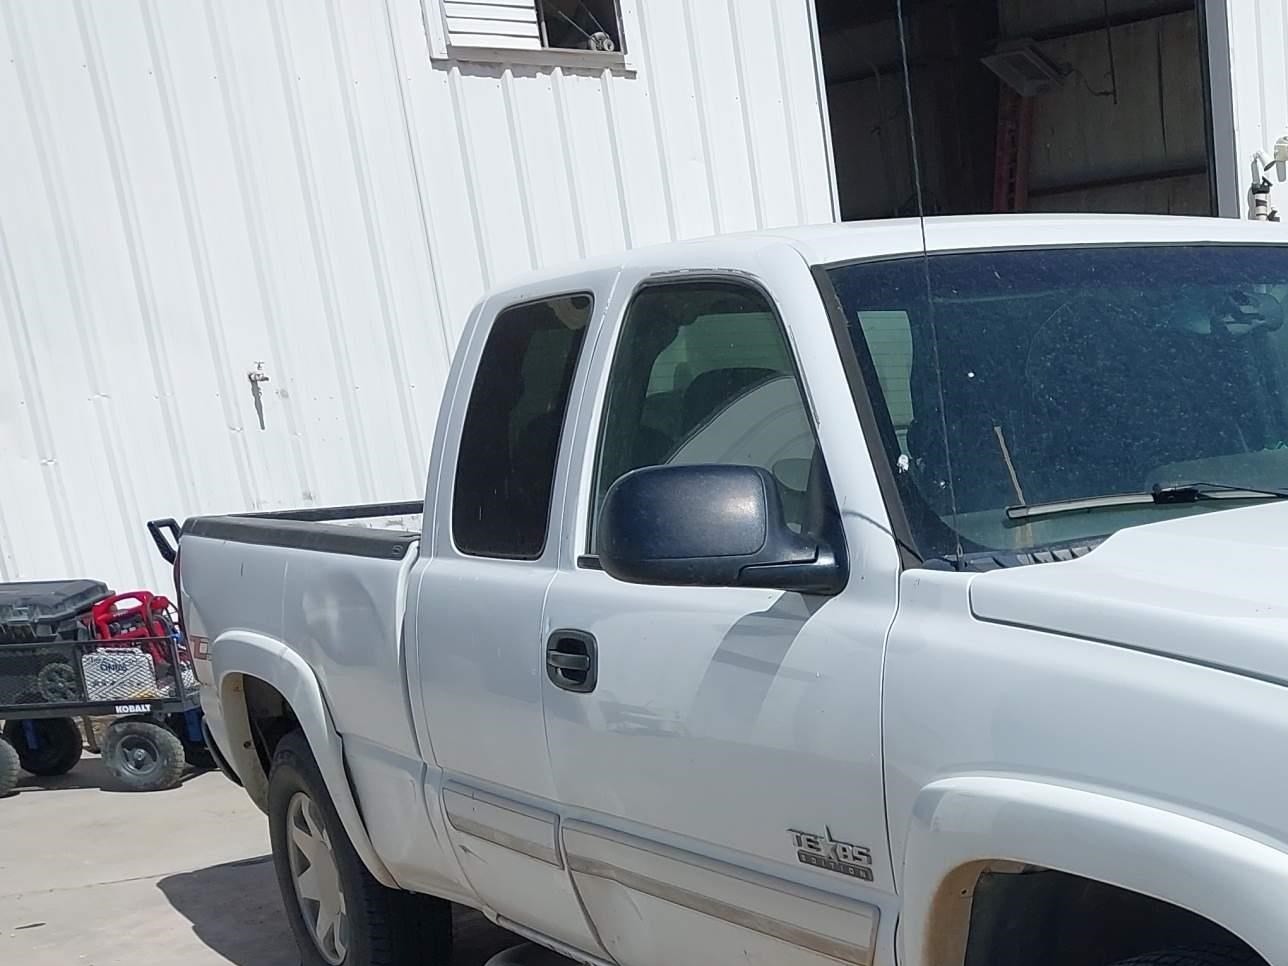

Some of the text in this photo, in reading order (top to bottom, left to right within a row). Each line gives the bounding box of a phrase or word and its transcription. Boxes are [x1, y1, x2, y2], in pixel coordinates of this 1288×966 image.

[115, 703, 152, 714] KOBALT
[787, 824, 873, 865] TEXAS
[800, 853, 867, 879] EDITION
